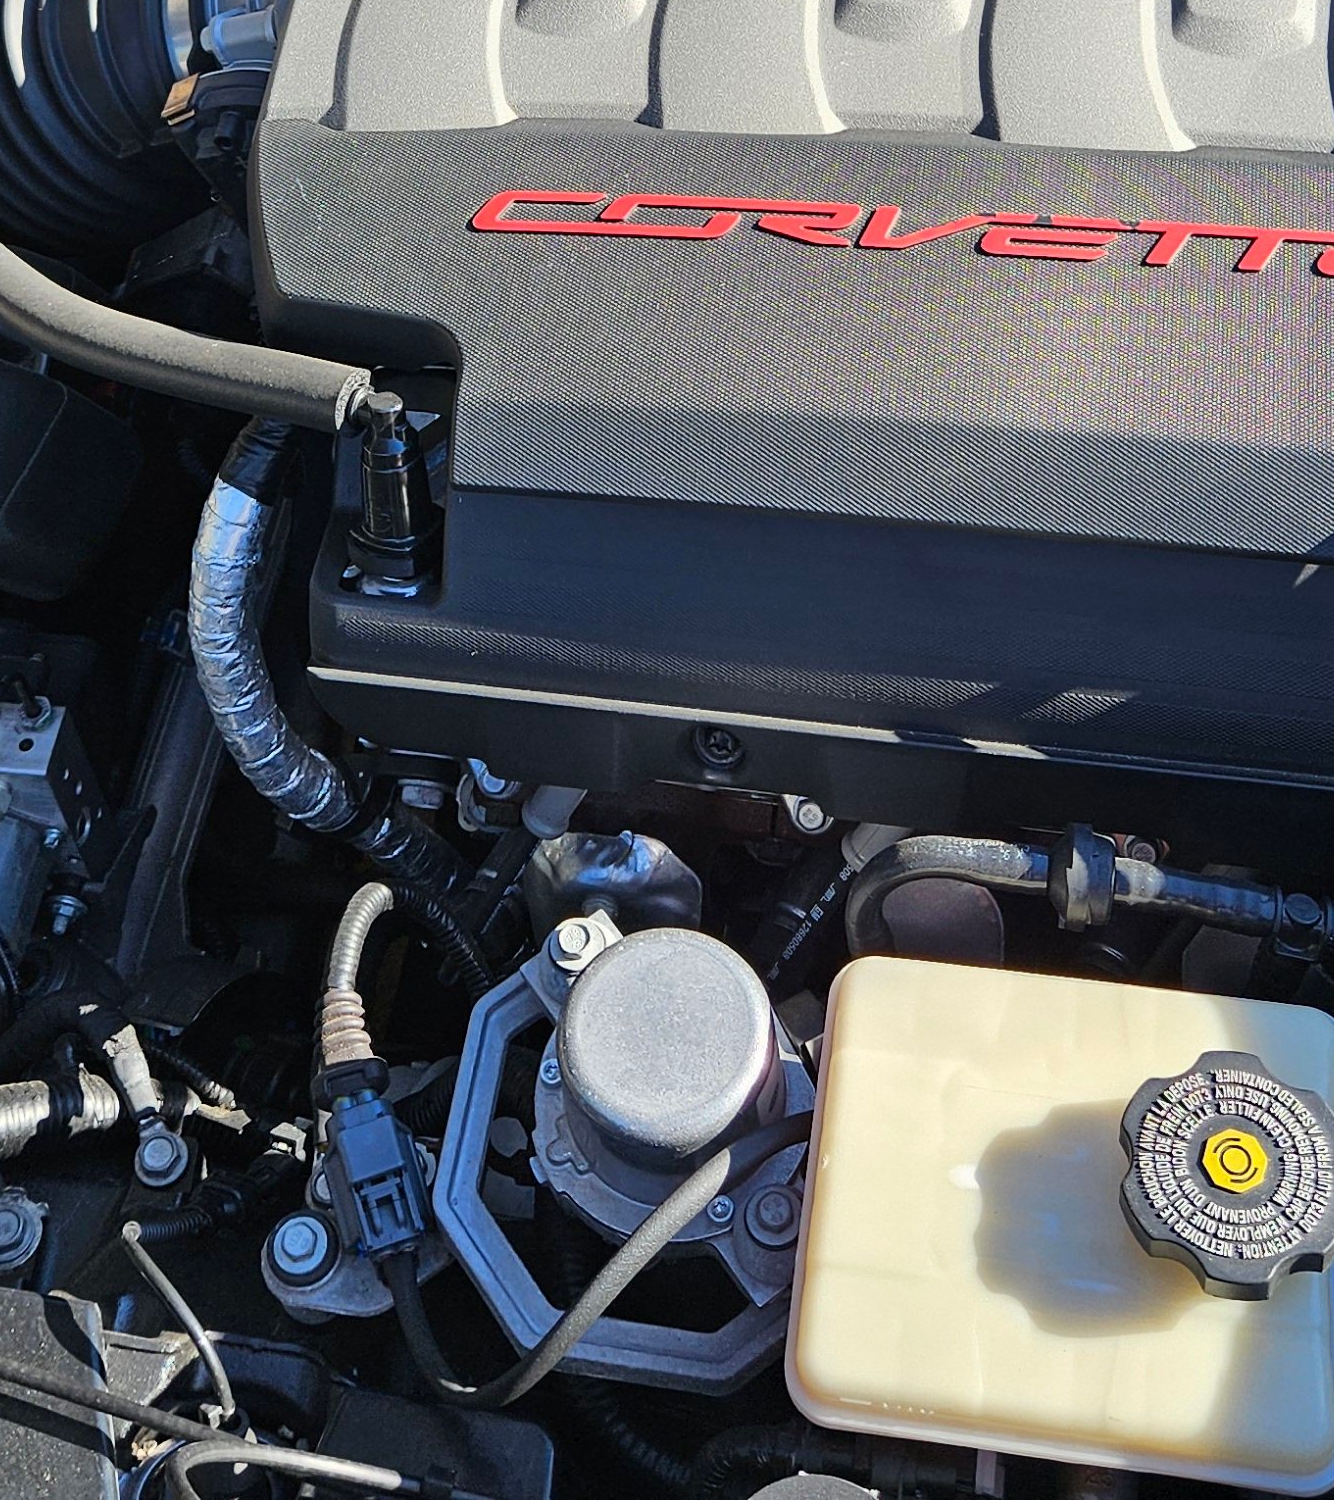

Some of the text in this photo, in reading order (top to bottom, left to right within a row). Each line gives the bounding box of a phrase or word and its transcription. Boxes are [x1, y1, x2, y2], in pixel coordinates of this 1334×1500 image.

[1215, 1085, 1244, 1100] ONLY
[1246, 1092, 1272, 1109] USE
[1152, 1100, 1172, 1117] LA
[1277, 1091, 1316, 1127] SEALED
[1140, 1115, 1161, 1151] AVANT
[1308, 1127, 1323, 1135] A
[1155, 1088, 1287, 1242] N'EMPLOYER QUE DU LIQUIDE DE FREIN DOT3
[1172, 1140, 1189, 1177] BIDON
[1220, 1100, 1299, 1208] WARNING: CLEAN FILLER
[1314, 1136, 1332, 1167] FROM
[1140, 1153, 1165, 1209] BOUCHON
[1180, 1178, 1206, 1207] D'UN
[1296, 1155, 1316, 1201] BEFORE
[1314, 1170, 1333, 1206] FLUID
[1160, 1205, 1178, 1226] LE
[1204, 1201, 1277, 1224] PROVENANT
[1286, 1198, 1308, 1220] CAP
[1299, 1203, 1325, 1234] DOT3
[1174, 1221, 1232, 1258] NETTOYER
